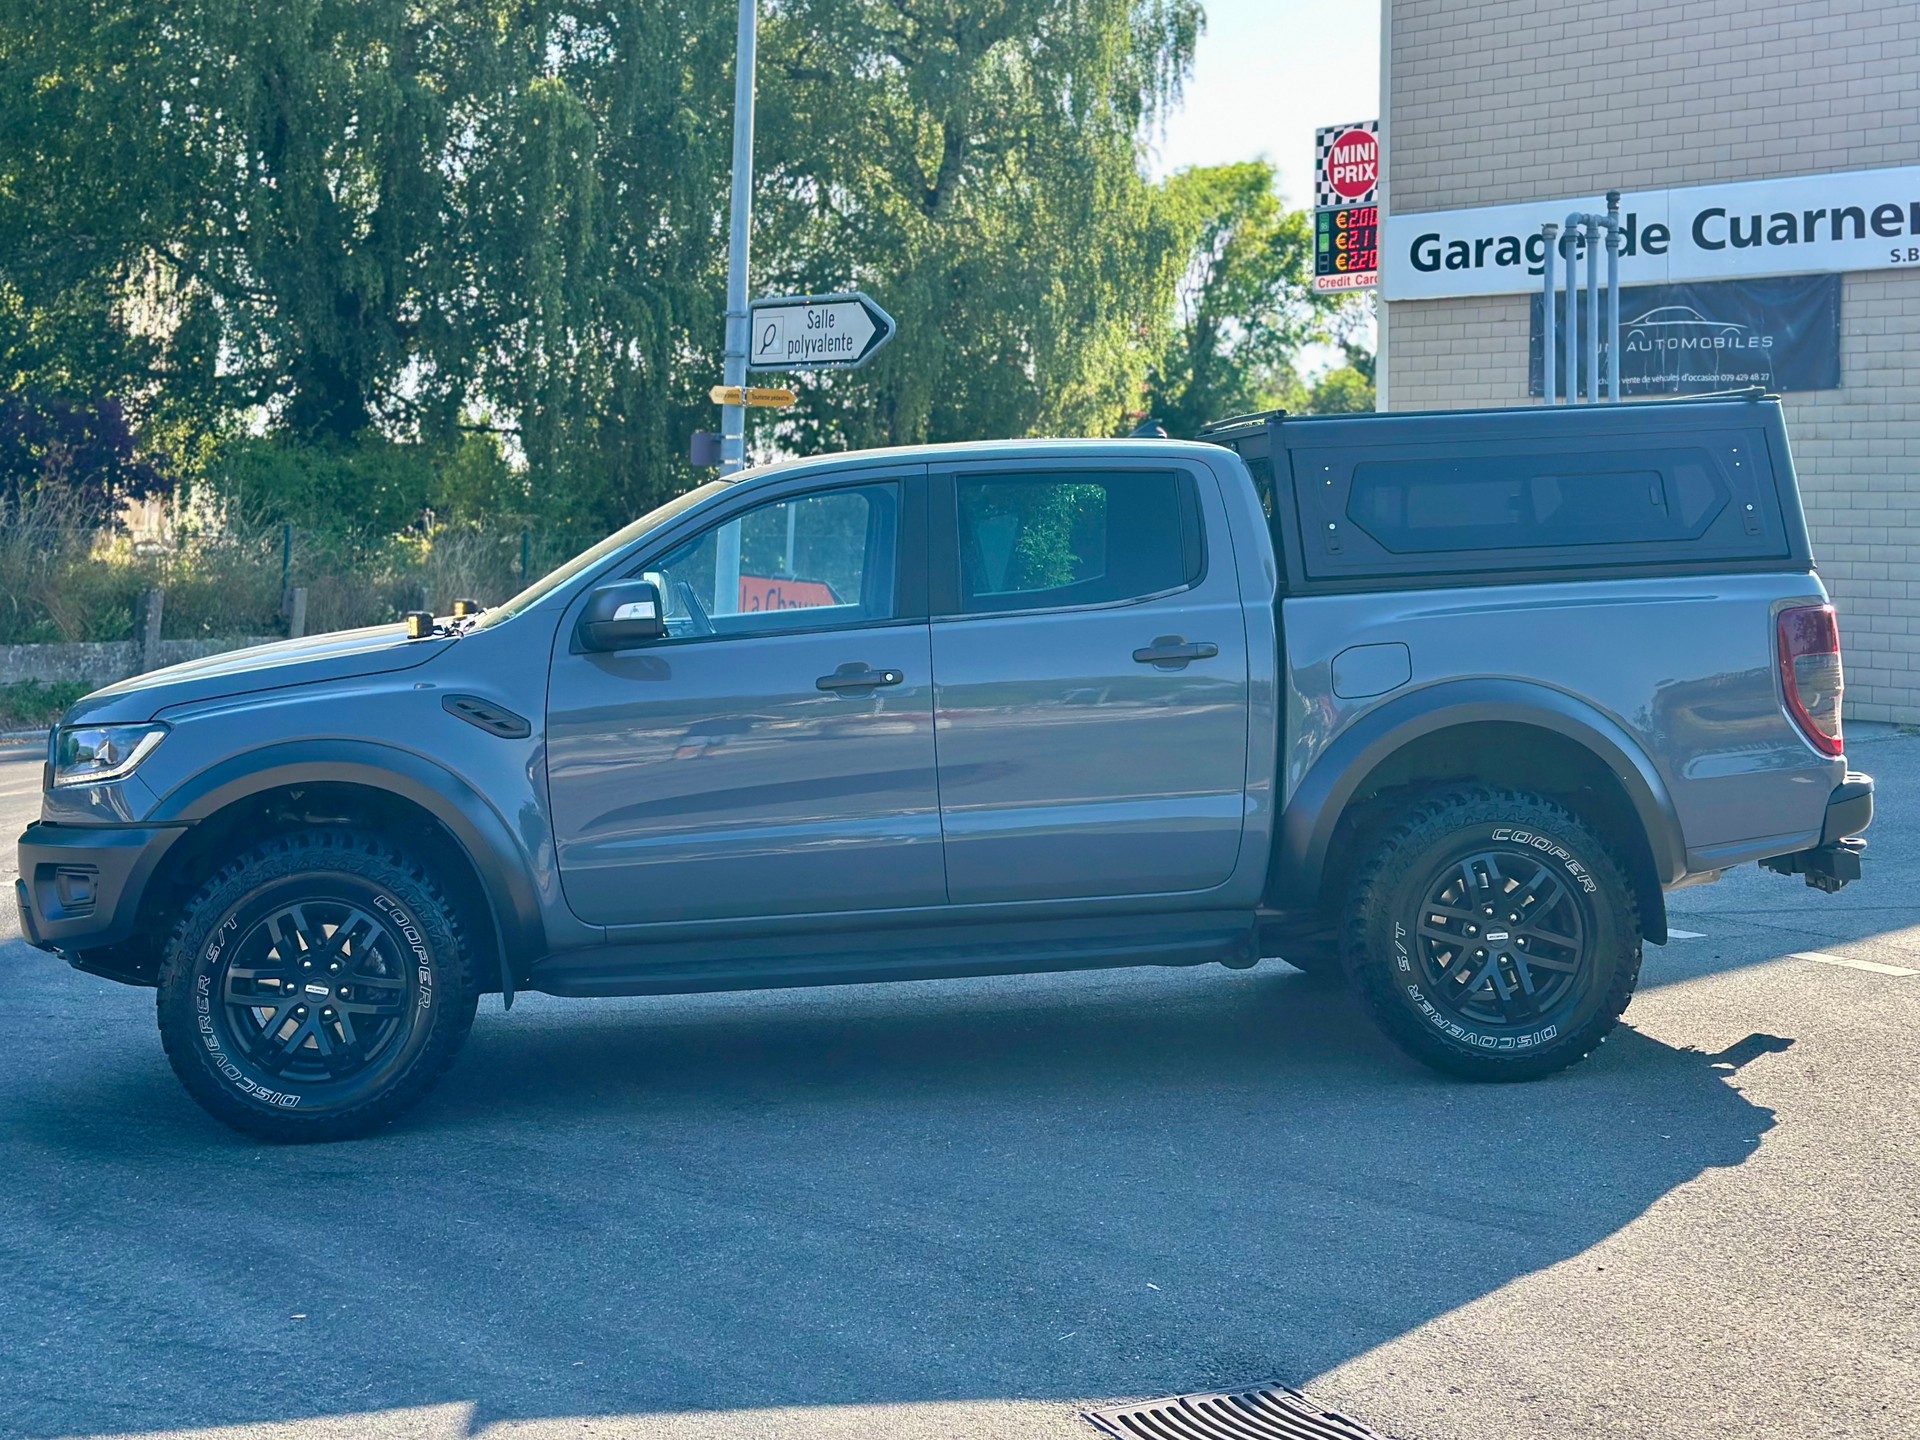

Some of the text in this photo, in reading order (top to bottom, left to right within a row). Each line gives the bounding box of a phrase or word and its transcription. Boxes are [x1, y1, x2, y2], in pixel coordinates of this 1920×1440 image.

[1333, 142, 1376, 164] MINI
[1333, 163, 1376, 185] PRIX
[1318, 275, 1351, 289] Credit
[807, 309, 835, 330] Salle
[787, 332, 853, 360] polyvalente
[1626, 335, 1773, 352] AUTOMOBILES
[1621, 376, 1641, 384] vente
[1641, 375, 1651, 384] de
[1720, 374, 1735, 382] 079
[1736, 374, 1749, 382] 429
[1749, 373, 1760, 381] 48
[1760, 372, 1770, 381] 27
[1491, 828, 1597, 893] COOPER
[373, 895, 432, 1009] COOPER
[1394, 921, 1557, 1049] DISCOVERER S/T
[196, 913, 301, 1108] DISCOVERER S/T
